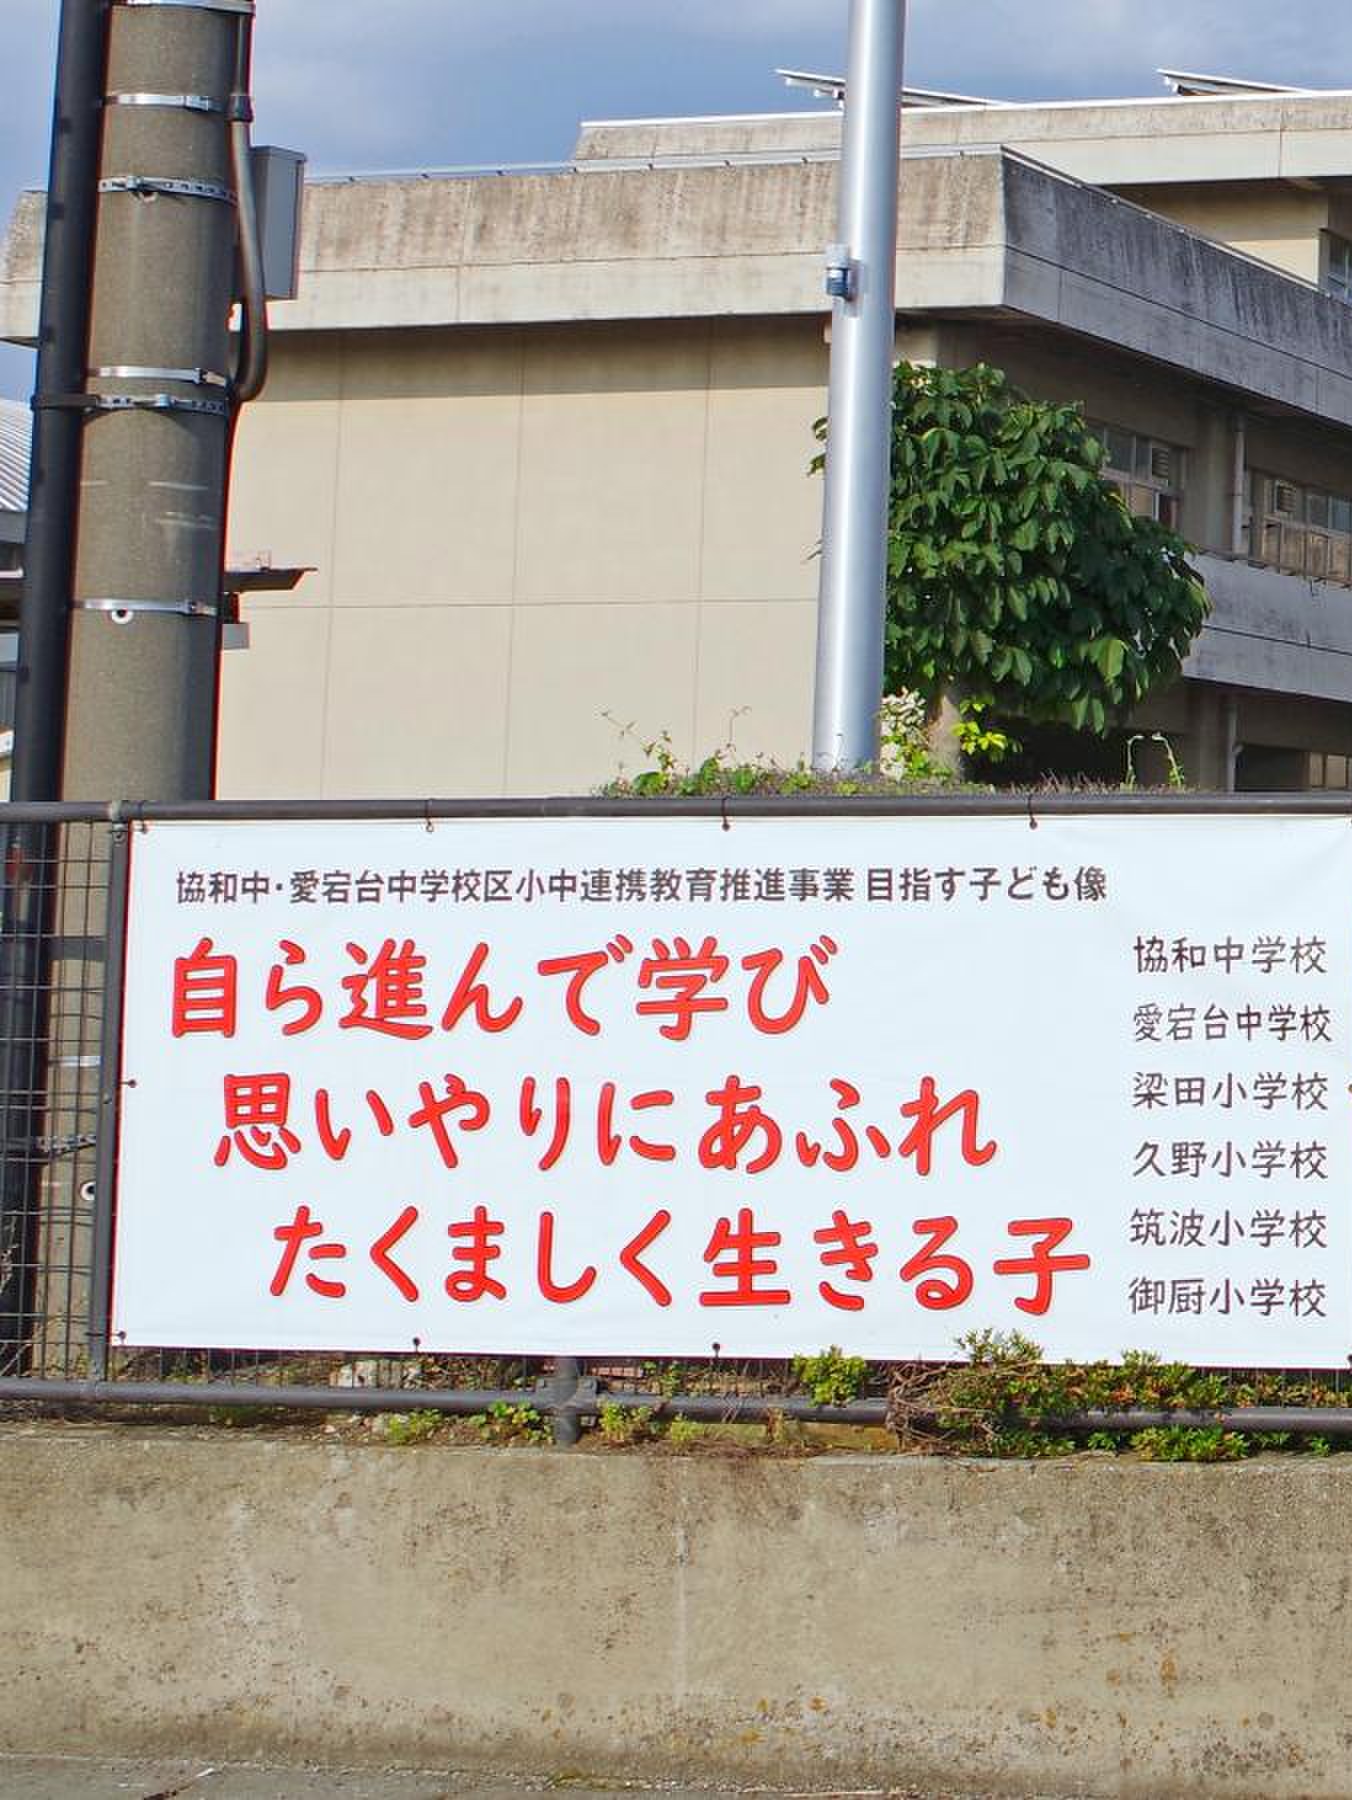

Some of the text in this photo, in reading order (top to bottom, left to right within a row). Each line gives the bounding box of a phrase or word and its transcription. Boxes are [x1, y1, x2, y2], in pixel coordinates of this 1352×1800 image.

[176, 865, 1107, 904] 協和中・愛宕台中学校区小中連携教育推進事業 目指す子ども像
[1132, 935, 1327, 974] 協和中学校
[171, 935, 836, 1041] 自ら進んで学び
[1132, 1002, 1332, 1043] 愛宕台中学校
[1131, 1071, 1328, 1111] 梁田小学校
[213, 1072, 998, 1175] 思いやりにあふれ
[1131, 1140, 1329, 1180] 久野小学校
[1129, 1207, 1328, 1249] 筑波小学校
[268, 1204, 1090, 1315] たくましく生きる子
[1127, 1276, 1328, 1318] 御厨小学校
